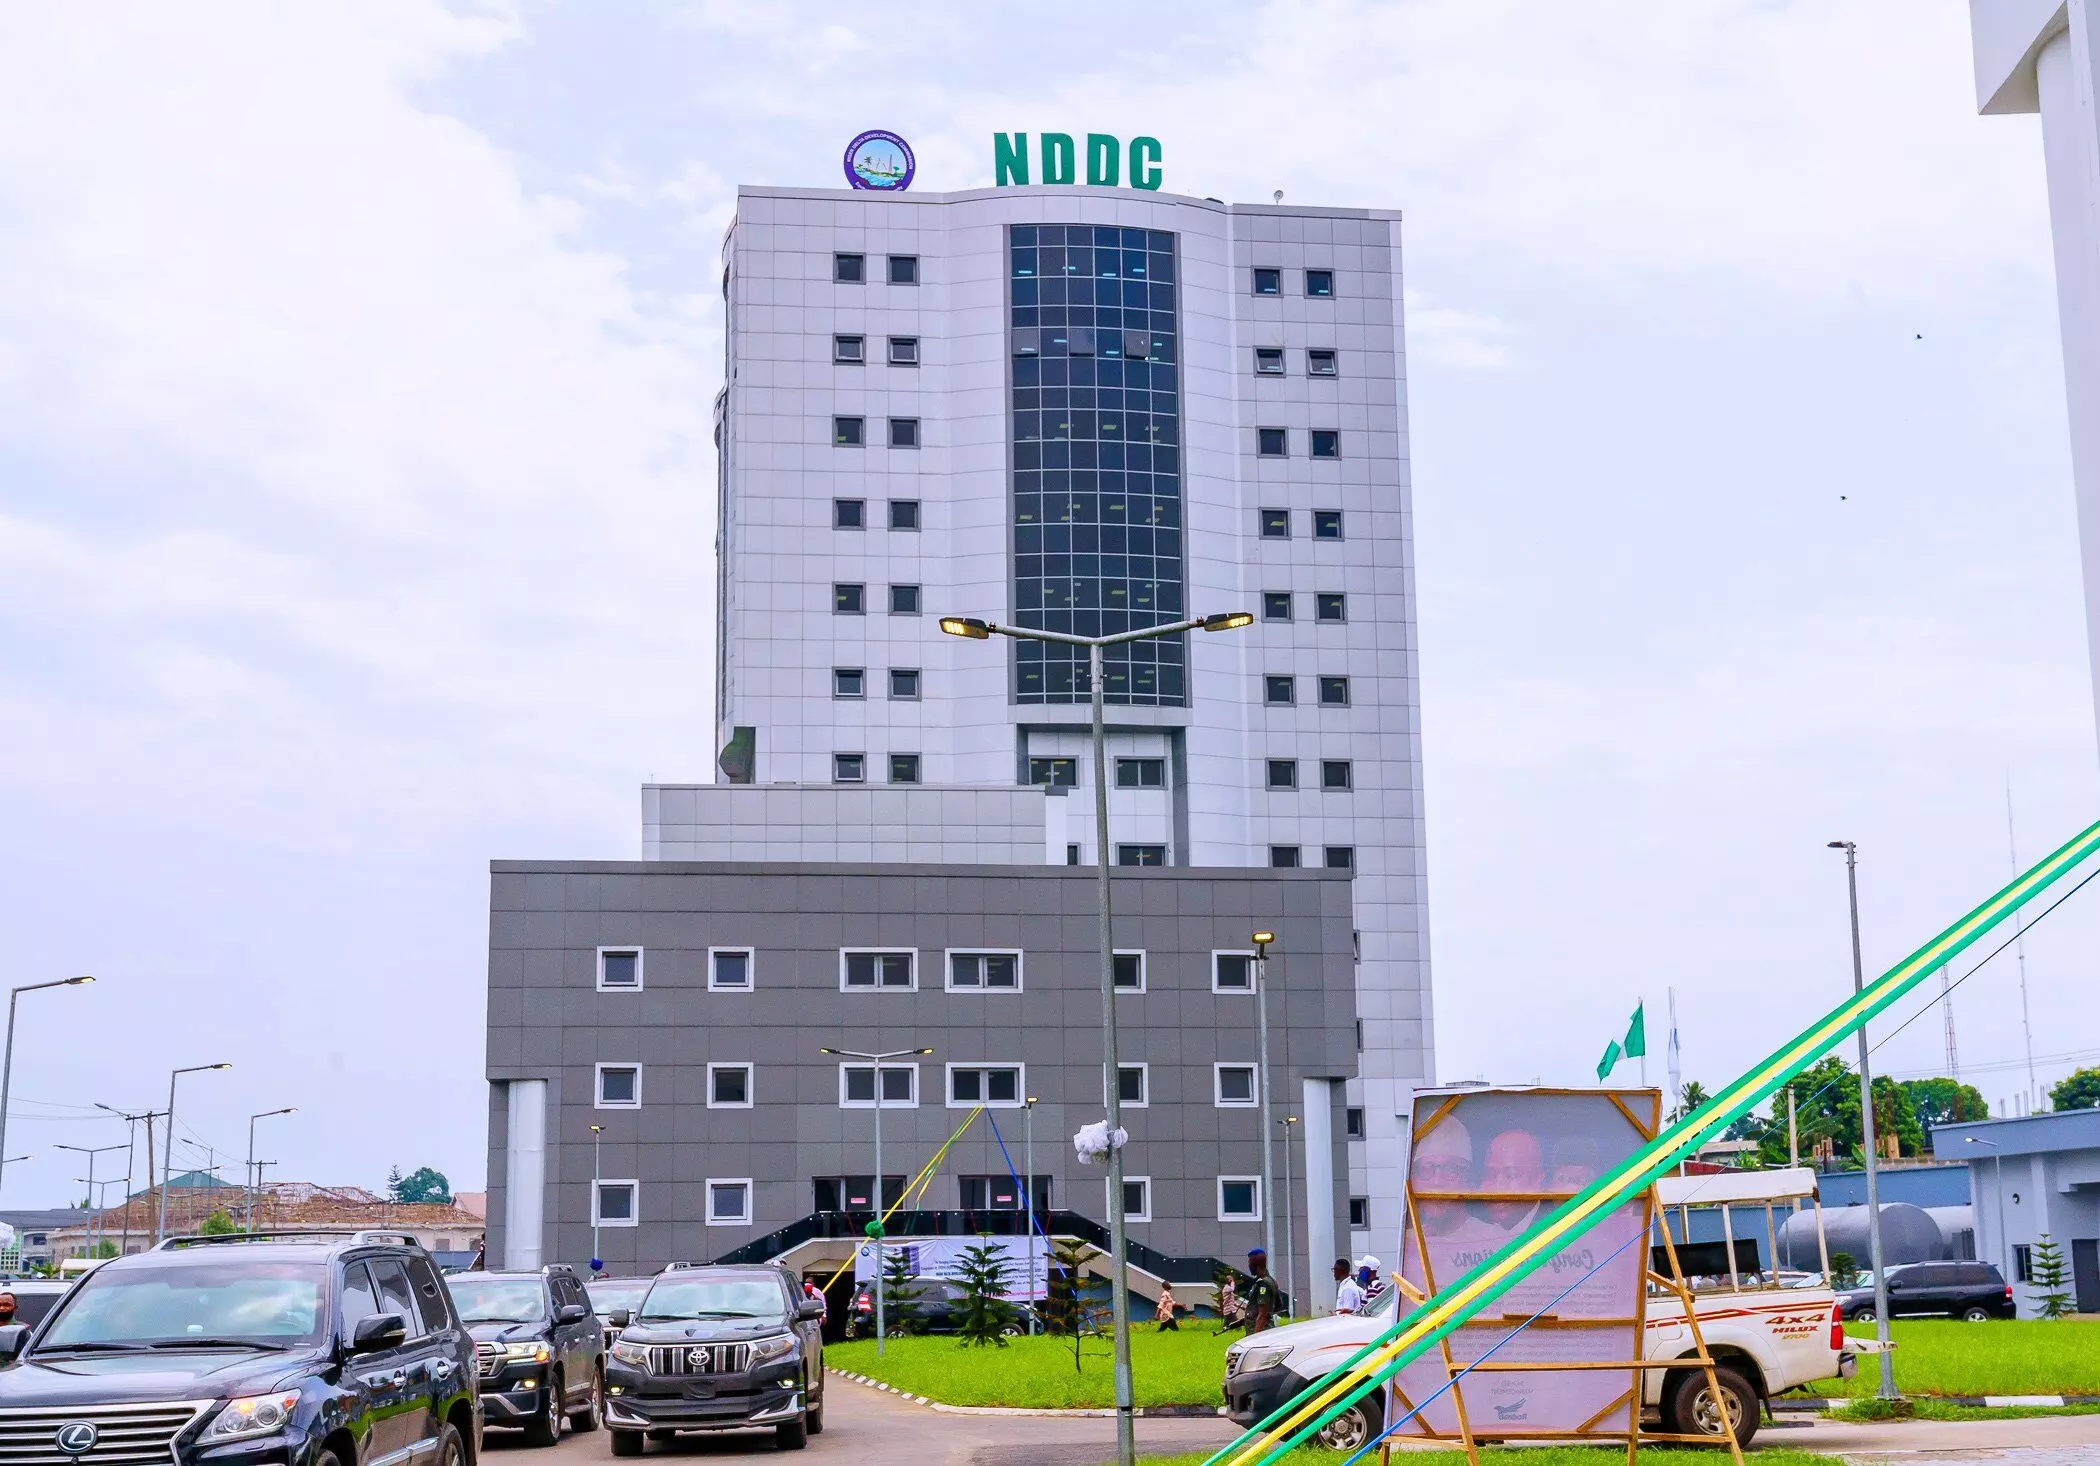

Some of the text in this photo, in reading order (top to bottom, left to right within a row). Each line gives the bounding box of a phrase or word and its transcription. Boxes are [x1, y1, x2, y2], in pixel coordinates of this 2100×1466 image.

[864, 133, 900, 143] DEVELOPMENT
[898, 142, 914, 170] COMMISSION
[993, 132, 1163, 191] NDDC
[1772, 1325, 1818, 1334] HILUX
